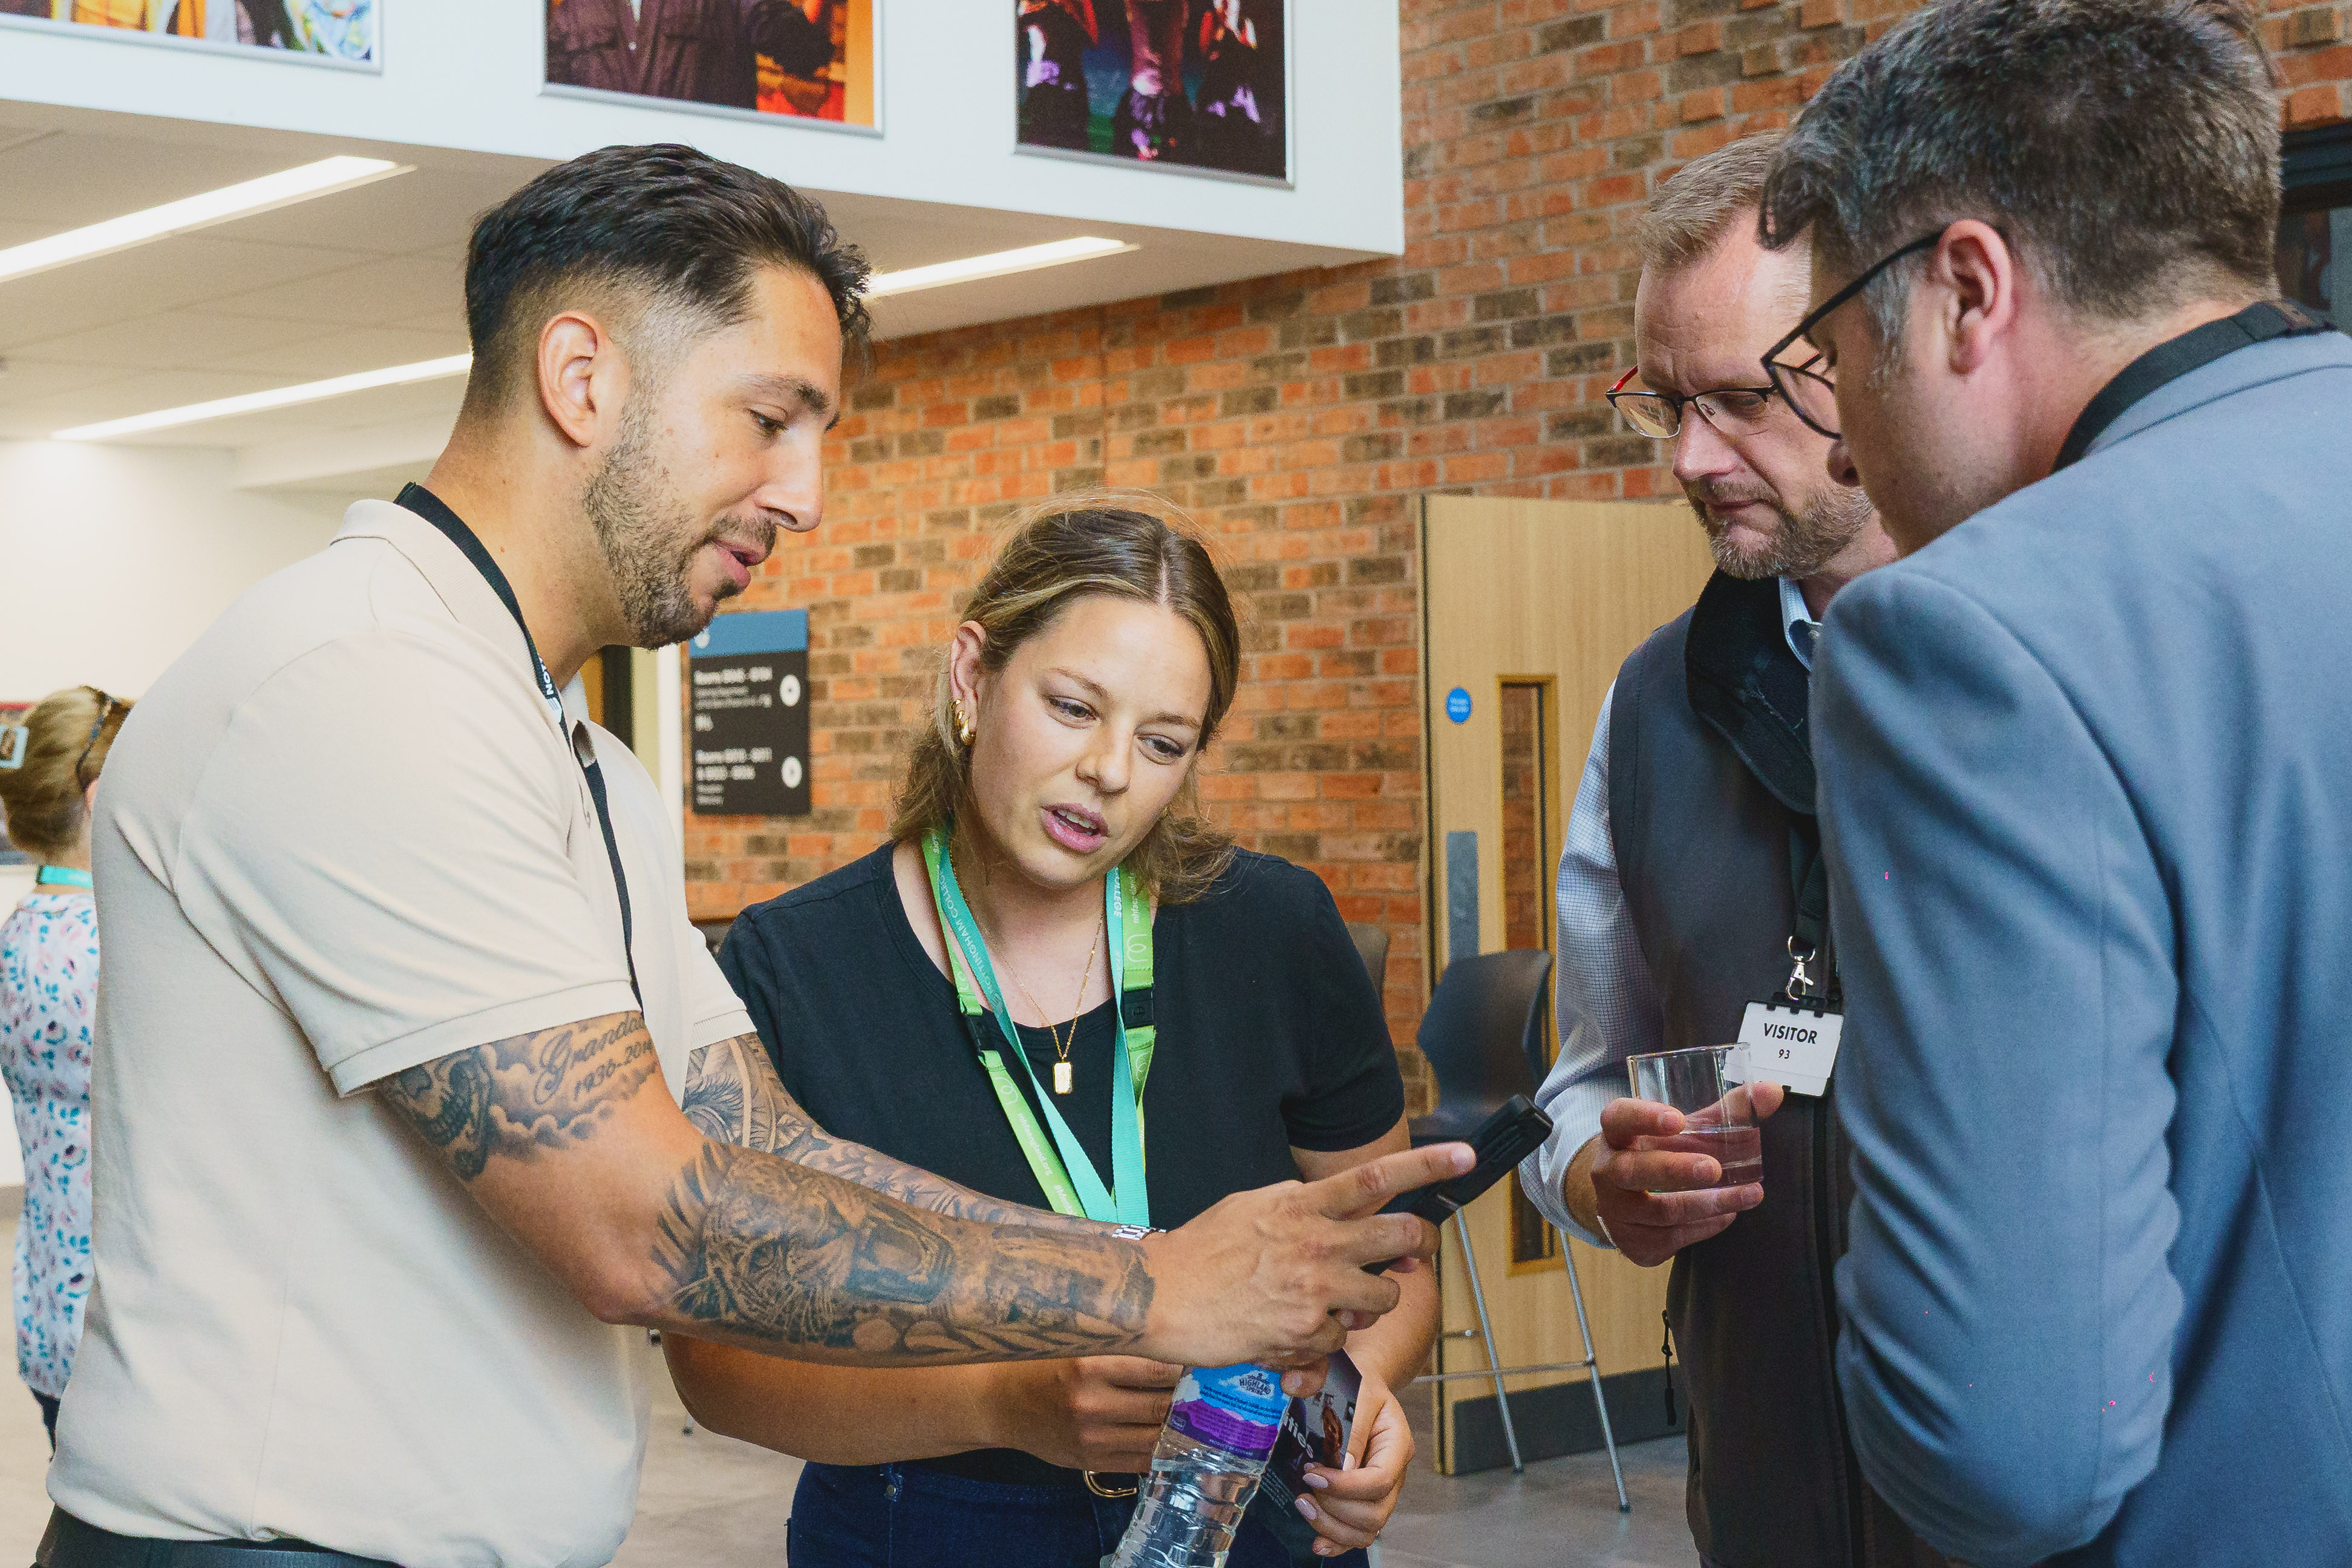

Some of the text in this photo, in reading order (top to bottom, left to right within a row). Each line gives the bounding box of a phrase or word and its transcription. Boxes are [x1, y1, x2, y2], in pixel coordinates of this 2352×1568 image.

[955, 918, 995, 991] NOTTINGHAM
[1763, 1022, 1818, 1045] VISITOR
[1778, 1048, 1791, 1059] 93
[1018, 1112, 1053, 1177] mhfaengland.org
[1239, 1379, 1272, 1395] HIGHLAND
[1246, 1385, 1263, 1396] SPRING
